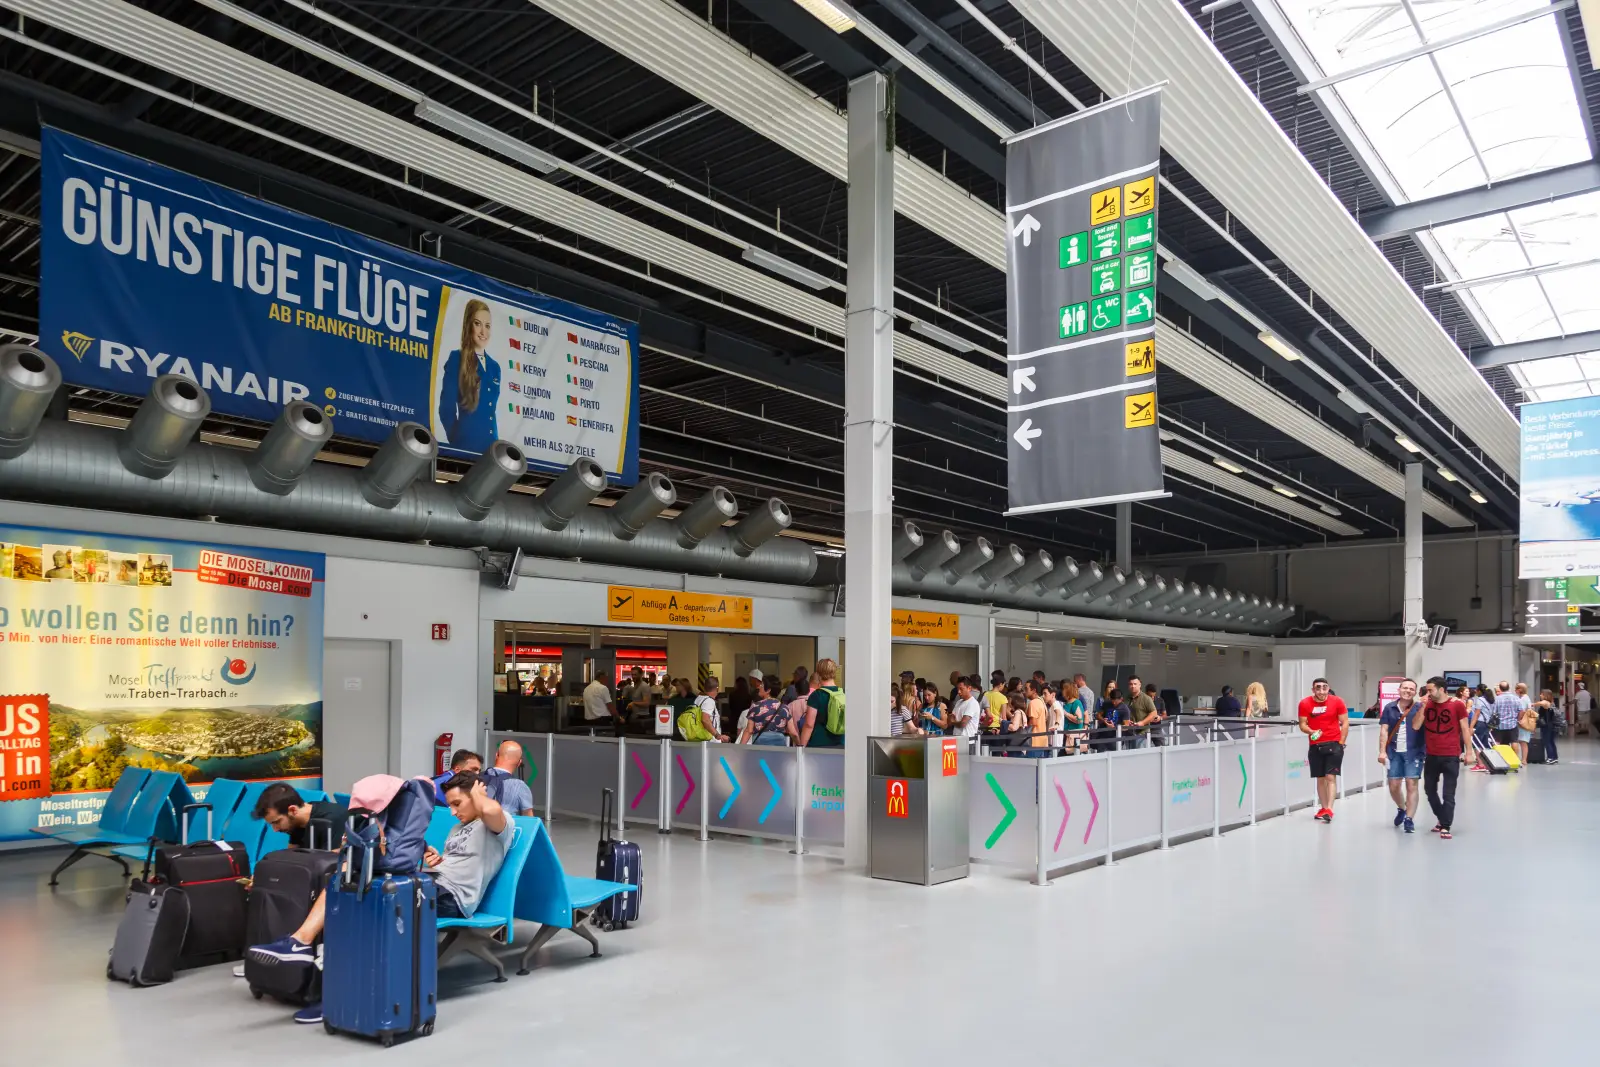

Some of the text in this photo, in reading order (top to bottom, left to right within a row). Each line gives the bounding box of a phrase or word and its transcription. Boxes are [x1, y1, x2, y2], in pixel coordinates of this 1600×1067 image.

[1110, 204, 1116, 214] B
[1094, 224, 1118, 236] lost and
[1098, 231, 1115, 241] found
[62, 176, 429, 340] GÜNSTIGE FLÜGE
[1092, 264, 1104, 272] rent
[1104, 297, 1120, 308] WC
[268, 302, 428, 360] AB FRANKFURT-HAHN
[523, 321, 549, 337] DUBLIN
[523, 342, 536, 354] FEZ
[522, 363, 547, 378] KERRY
[523, 384, 551, 400] LONDON
[338, 392, 415, 415] ZUGEWIESENE SITZPLÄTZE
[346, 411, 368, 422] GRATIS
[522, 406, 555, 421] MAILAND
[1144, 409, 1152, 419] A
[578, 418, 614, 434] TENERIFFA
[524, 436, 596, 458] MEHR ALS 32 ZIELE
[202, 552, 311, 581] DIE MOSEL.KOMM
[227, 572, 310, 596] DieMosel.com
[641, 600, 666, 611] Abflüge
[668, 595, 678, 610] A
[684, 603, 716, 614] departures
[718, 600, 726, 614] A
[20, 604, 117, 630] wollen
[128, 608, 170, 632] Sie
[180, 610, 238, 635] denn
[247, 613, 294, 636] hin?
[668, 612, 690, 622] Gates
[906, 614, 914, 626] A
[937, 616, 943, 628] A
[8, 632, 35, 642] Min.
[38, 635, 58, 644] von
[62, 634, 86, 644] hier:
[90, 634, 112, 644] Eine
[116, 637, 176, 646] romantische
[180, 638, 200, 648] Welt
[204, 638, 230, 648] voller
[232, 640, 280, 649] Erlebnisse.
[108, 674, 143, 686] Mosel
[105, 688, 238, 699] www.Traben-Trarbach.de
[16, 752, 42, 776] in
[812, 784, 844, 798] frank
[40, 814, 76, 827] Wein,
